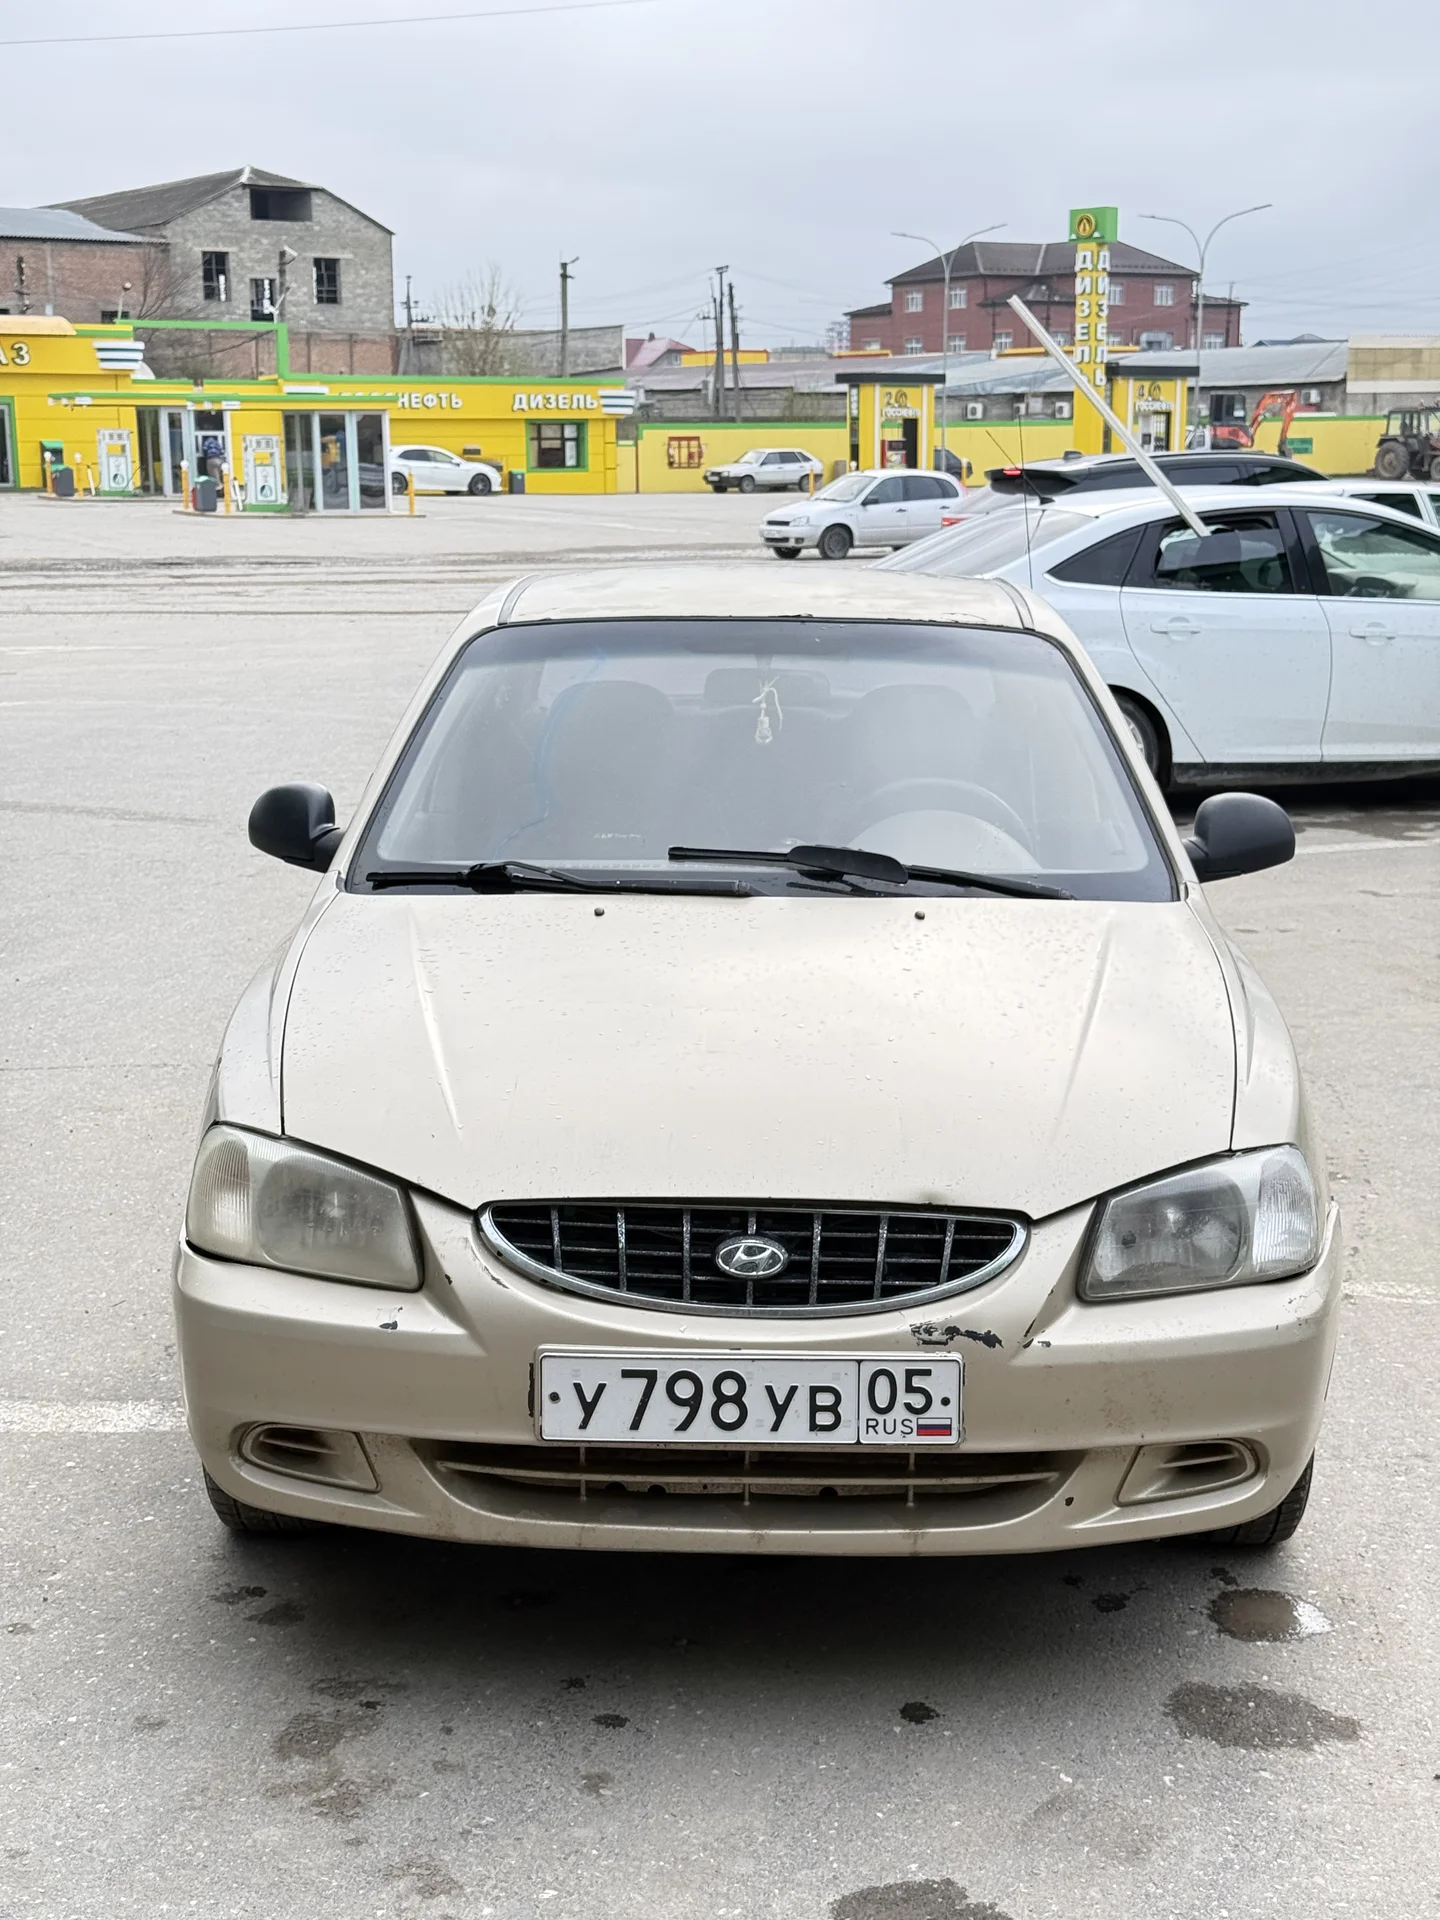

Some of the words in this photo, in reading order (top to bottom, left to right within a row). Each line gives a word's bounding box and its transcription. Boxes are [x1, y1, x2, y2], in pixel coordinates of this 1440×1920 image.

[1094, 250, 1110, 386] ДИЗЕЛЬ
[512, 393, 598, 412] ДИЗЕЛЬ
[573, 1368, 842, 1433] У798УВ
[867, 1367, 932, 1416] 05
[865, 1418, 914, 1436] RUS
